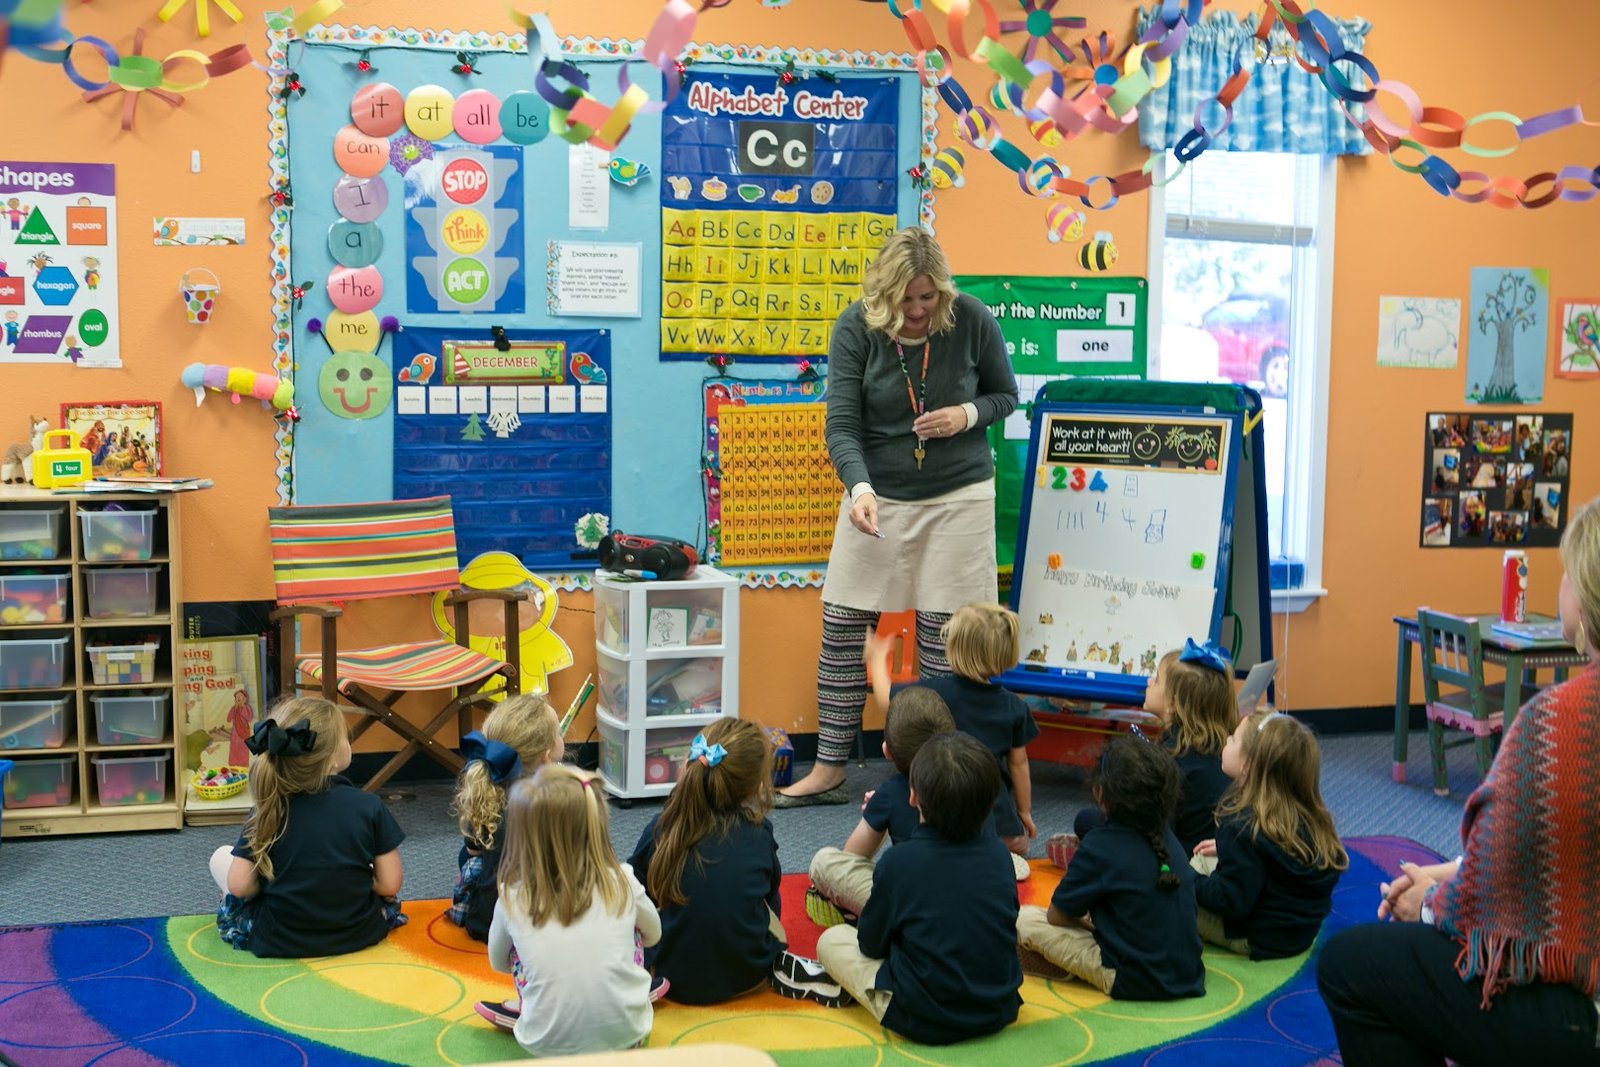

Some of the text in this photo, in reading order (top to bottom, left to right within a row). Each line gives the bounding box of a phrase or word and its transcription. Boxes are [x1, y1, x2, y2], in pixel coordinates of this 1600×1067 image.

[689, 82, 867, 119] Alphabet Center
[371, 96, 539, 128] it at all be
[347, 140, 380, 154] can
[747, 129, 807, 168] Cc
[444, 170, 486, 192] STOP
[348, 183, 371, 208] I
[72, 222, 102, 231] square
[445, 216, 484, 242] Think
[669, 220, 696, 237] Aa
[702, 220, 729, 239] Bb
[736, 221, 761, 238] Cc
[769, 223, 795, 241] Dd
[804, 224, 826, 242] Ee
[838, 223, 858, 241] Ff
[21, 232, 55, 242] triangle
[345, 231, 362, 248] a
[36, 281, 75, 291] hexagon
[339, 275, 375, 297] the
[447, 270, 485, 292] ACT
[0, 286, 15, 296] gle
[1010, 302, 1035, 318] the
[1039, 303, 1102, 320] Number
[1119, 301, 1125, 318] 1
[24, 329, 62, 338] rhombus
[84, 323, 102, 331] oval
[340, 322, 368, 335] me
[1021, 337, 1039, 355] is:
[1082, 341, 1109, 352] one
[473, 356, 538, 368] DECEMBER
[731, 382, 782, 396] Numbers
[1052, 426, 1132, 440] Work at it with
[1054, 440, 1130, 454] all your heart!
[56, 464, 63, 473] 4
[1037, 465, 1108, 492] 1 2 3 4
[723, 505, 731, 513] 61
[735, 504, 745, 513] 62
[748, 504, 758, 512] 63
[760, 503, 770, 512] 64
[773, 503, 783, 511] 65
[785, 503, 795, 511] 66
[798, 502, 807, 510] 67
[810, 501, 820, 510] 68
[823, 501, 833, 509] 69
[724, 515, 833, 527] 71 72 73 74 75 76 77 78 79
[724, 530, 833, 542] 81 82 83 84 85 86 87 88 89
[724, 548, 732, 556] 91
[736, 547, 746, 556] 92
[748, 547, 758, 556] 93
[761, 546, 771, 555] 94
[773, 546, 784, 555] 95
[785, 545, 796, 554] 96
[798, 545, 808, 553] 97
[811, 544, 821, 553] 98
[183, 664, 214, 677] ping
[184, 678, 233, 693] ng God
